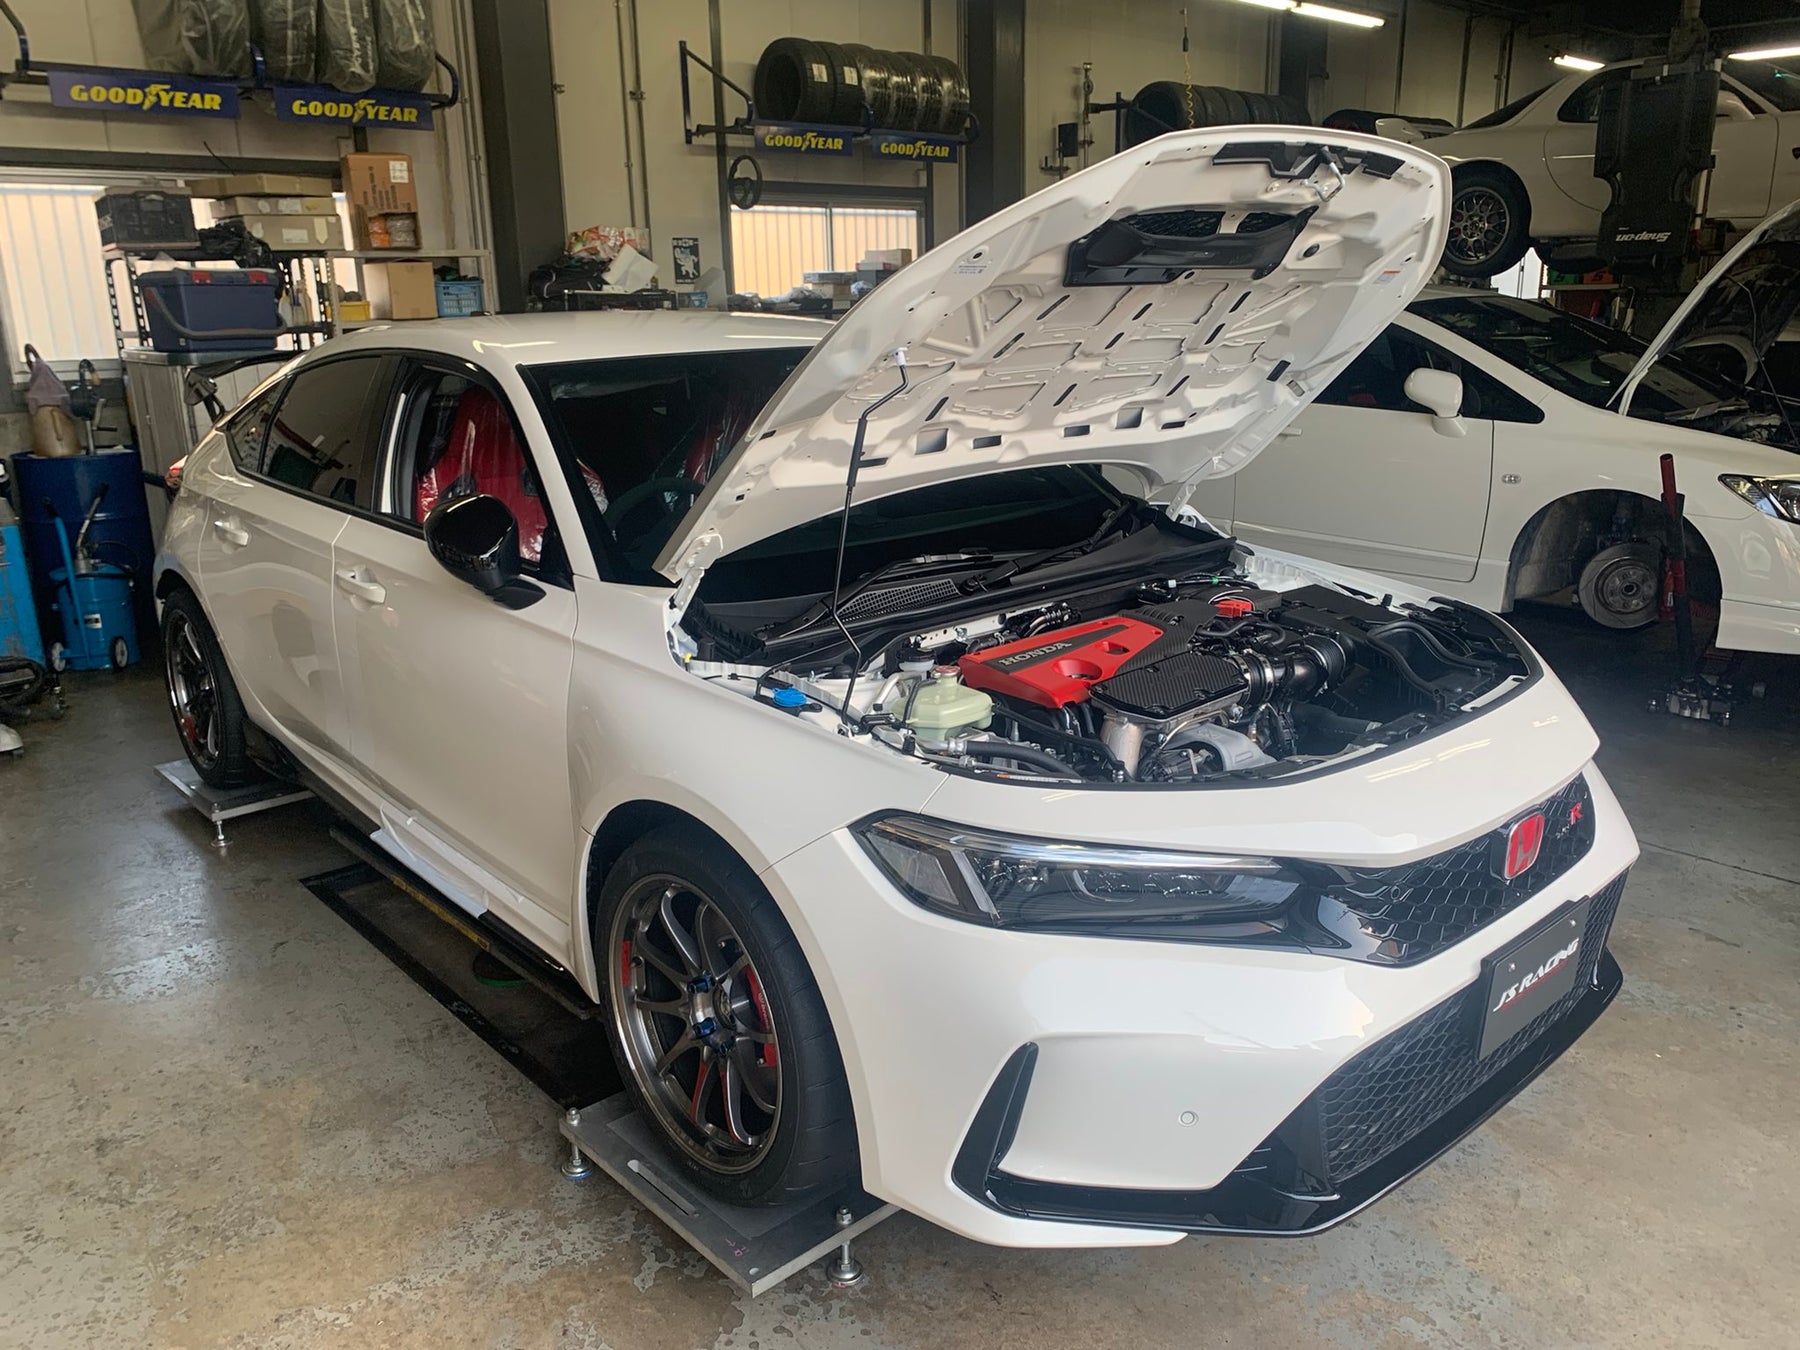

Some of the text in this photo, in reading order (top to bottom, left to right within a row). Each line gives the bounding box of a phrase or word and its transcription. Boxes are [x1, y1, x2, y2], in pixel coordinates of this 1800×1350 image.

[70, 84, 222, 111] GOODYEAR
[292, 99, 418, 123] GOODYEAR
[764, 132, 844, 151] GOODYEAR
[880, 141, 950, 158] GOODYEAR
[998, 642, 1073, 666] HONDA
